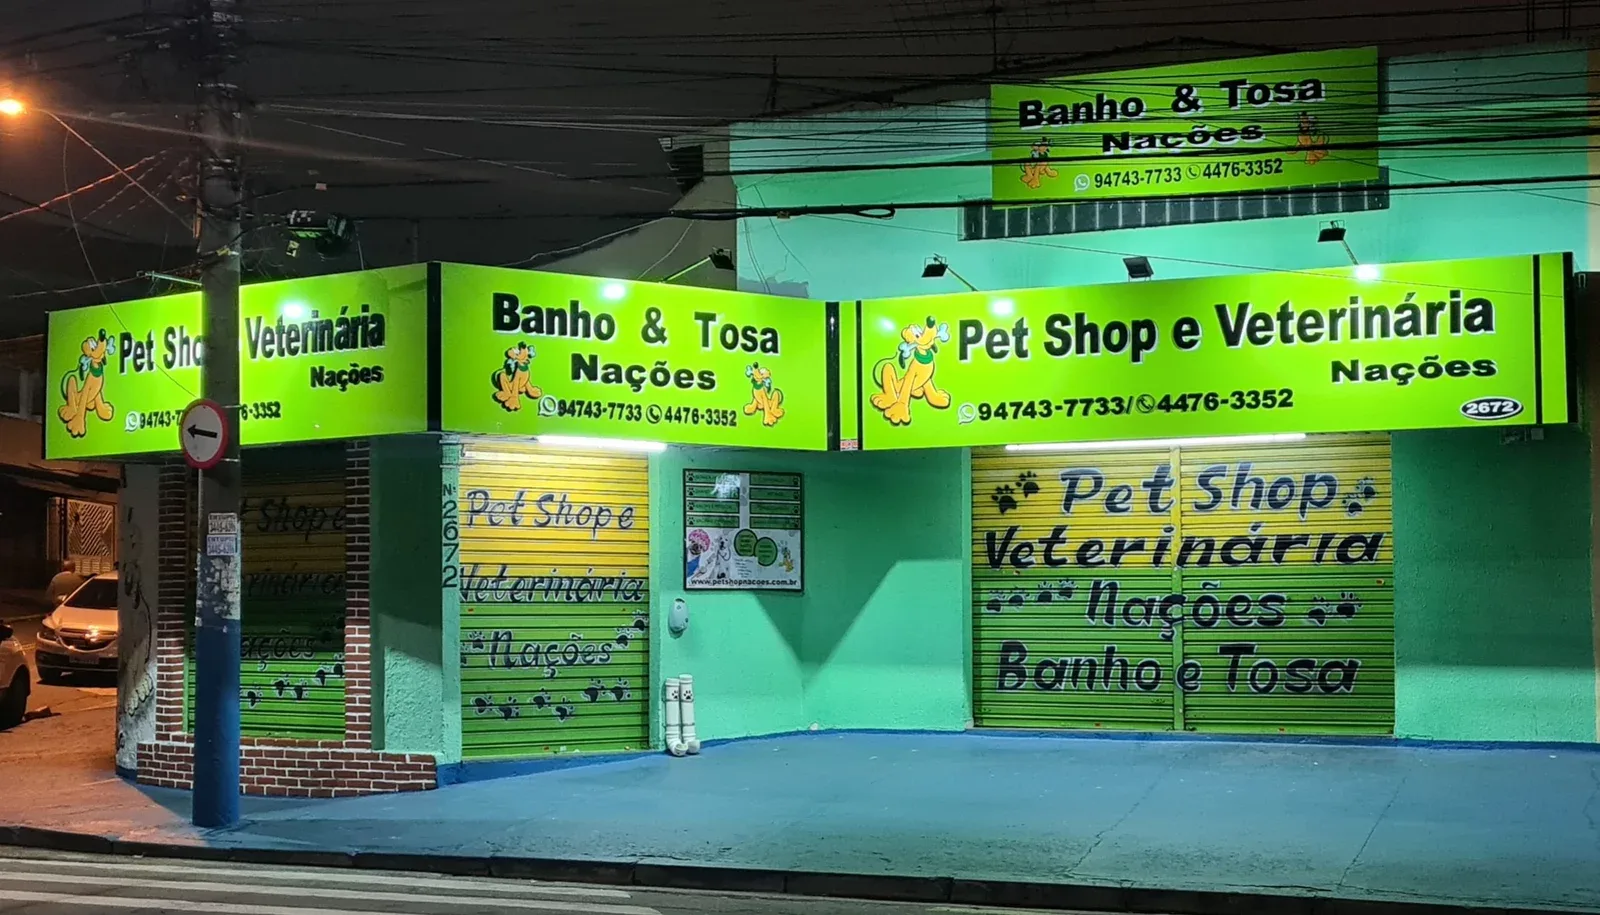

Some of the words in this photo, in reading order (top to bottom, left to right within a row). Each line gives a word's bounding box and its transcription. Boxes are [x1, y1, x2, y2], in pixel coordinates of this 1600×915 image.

[1019, 94, 1144, 128] Banho
[1171, 84, 1201, 114] &
[1219, 78, 1325, 110] Tosa
[1102, 124, 1264, 153] Nações
[1094, 168, 1182, 188] 94743-7733
[1202, 158, 1283, 179] 4476-3352
[119, 329, 154, 374] Pet
[163, 325, 205, 370] Sho
[245, 304, 385, 359] Veterinária
[492, 292, 616, 341] Banho
[641, 307, 668, 345] &
[694, 311, 780, 354] Tosa
[959, 317, 1029, 361] Pet
[1044, 313, 1157, 363] Shop
[1173, 316, 1201, 349] e
[1214, 290, 1494, 347] Veterinária
[310, 363, 385, 392] Nações
[571, 353, 716, 392] Nações
[1331, 355, 1497, 386] Nações
[558, 399, 642, 421] 94743-7733
[665, 409, 737, 427] 4476-3352
[1157, 388, 1293, 414] 4476-3352
[1466, 400, 1514, 414] 2672
[1059, 463, 1176, 515] Pet
[1193, 461, 1338, 521] Shop
[466, 489, 527, 528] Pet
[534, 492, 612, 541] Shop
[618, 506, 635, 529] e
[984, 522, 1385, 570] Veterinária
[460, 564, 645, 602] Veterinária
[691, 578, 797, 586] www.petshopnacoes.com.br
[1085, 578, 1288, 641] Nações
[241, 629, 317, 672] ações
[489, 629, 613, 678] Nações
[997, 640, 1163, 693] Banho
[1176, 660, 1202, 693] e
[1217, 642, 1361, 694] Tosa
